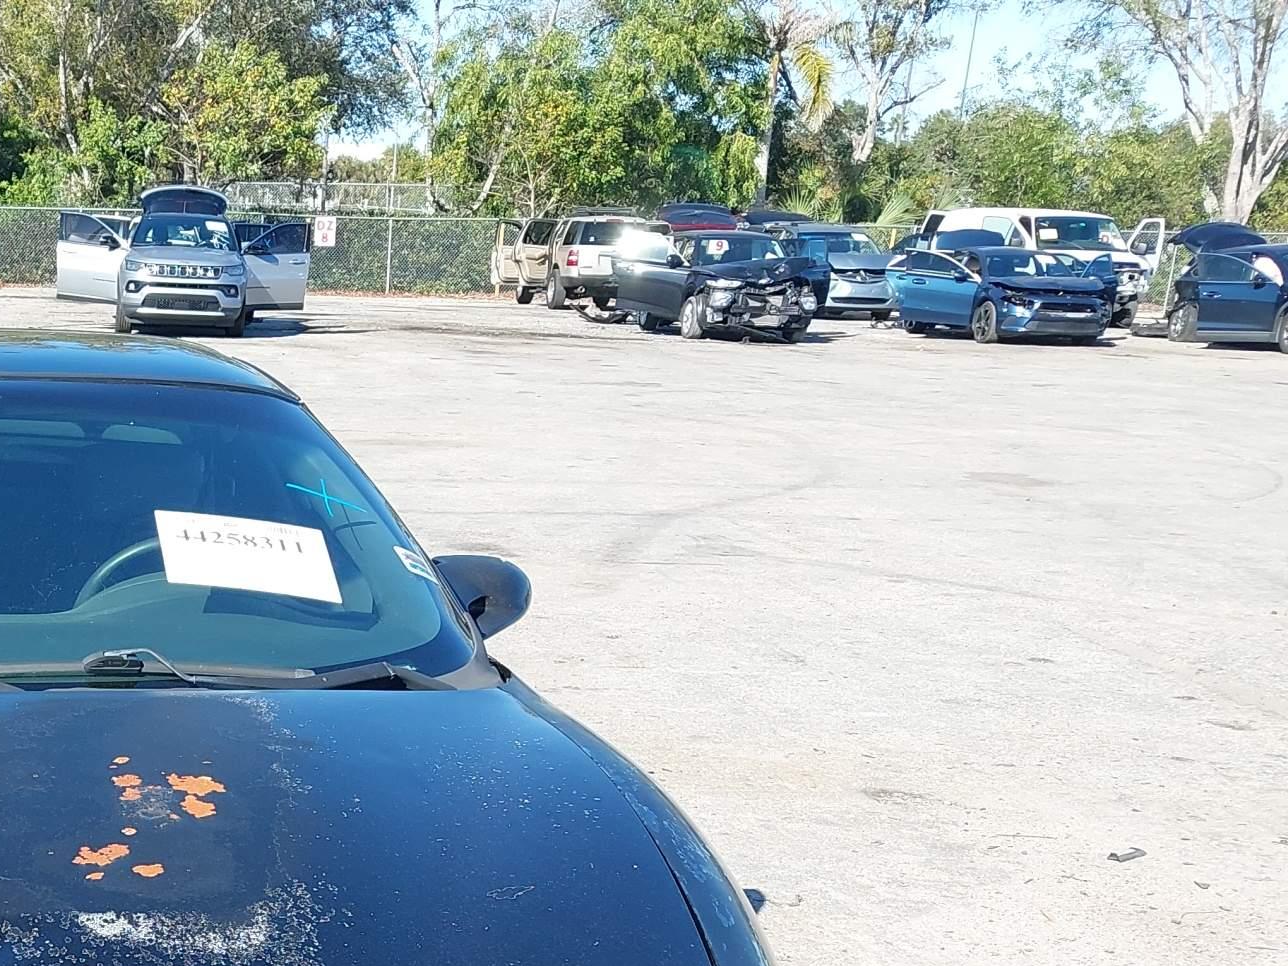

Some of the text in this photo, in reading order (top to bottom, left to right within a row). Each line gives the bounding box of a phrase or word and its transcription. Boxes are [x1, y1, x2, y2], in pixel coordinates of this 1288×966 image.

[317, 220, 334, 231] DZ
[322, 232, 328, 243] 8
[716, 240, 724, 251] 9
[175, 528, 304, 554] 44258311
